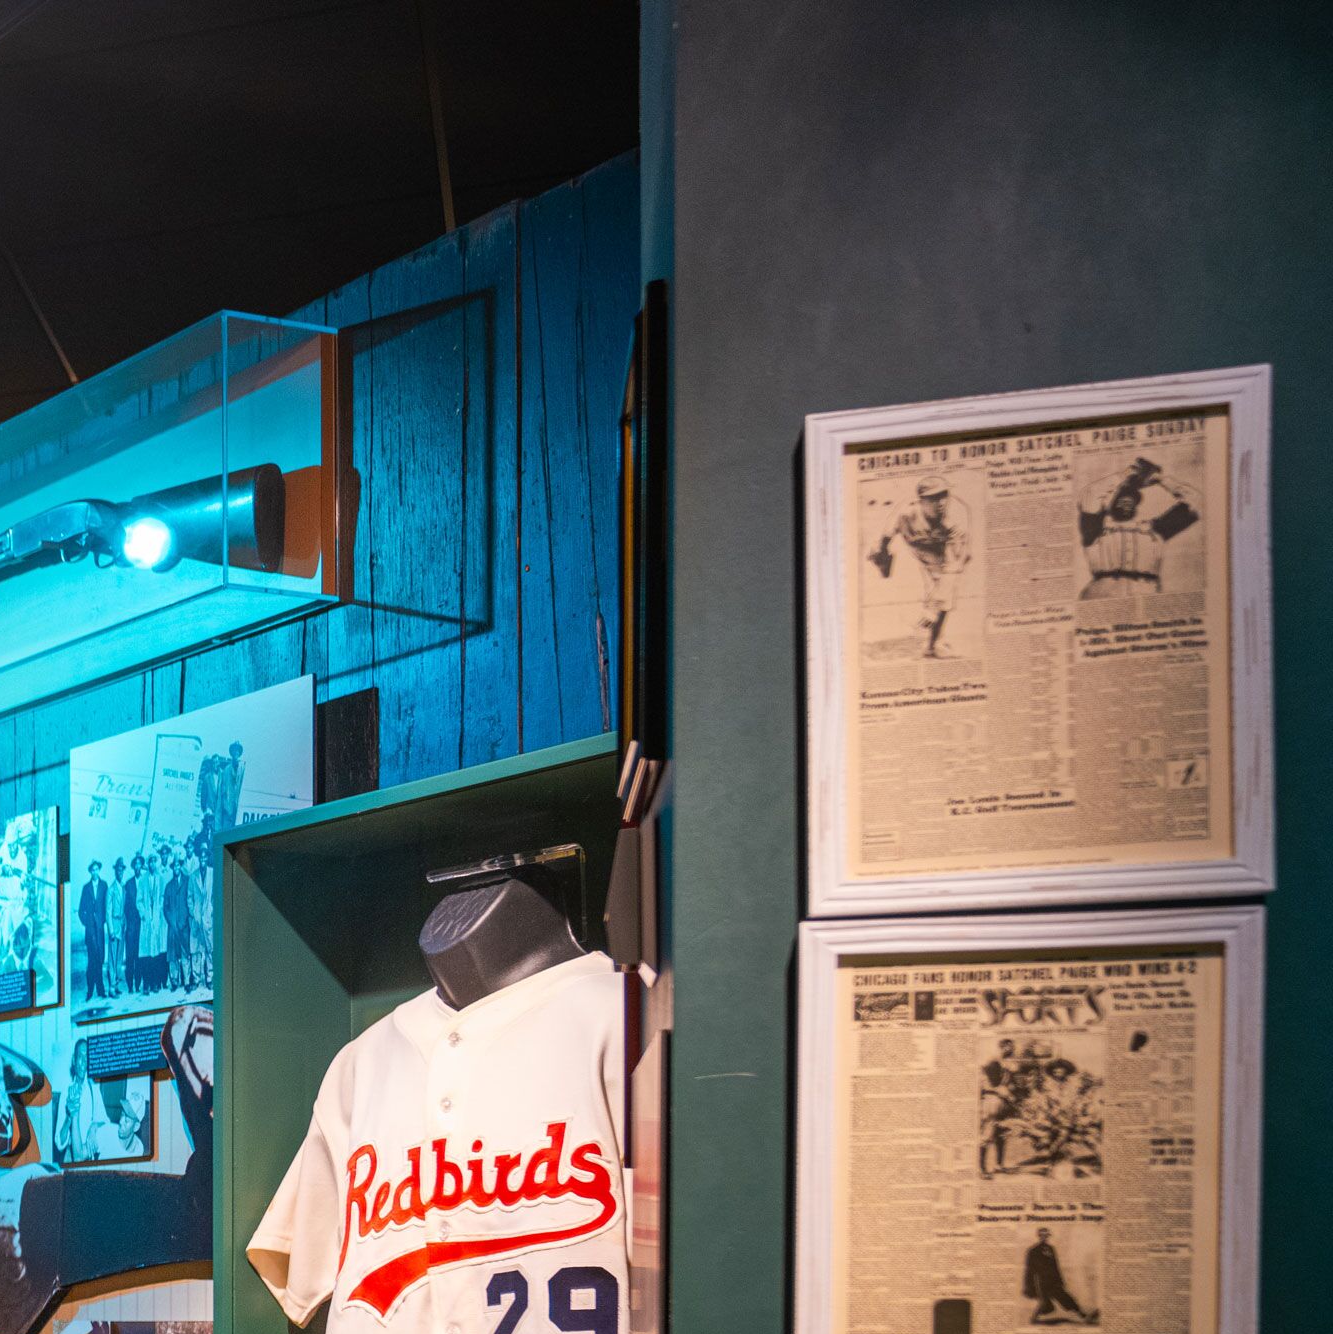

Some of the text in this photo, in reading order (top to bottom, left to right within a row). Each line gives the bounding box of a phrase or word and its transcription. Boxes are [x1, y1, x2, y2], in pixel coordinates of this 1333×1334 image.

[857, 417, 1207, 470] CHICAGO TO HONOR SATCHEL PAIGE SUNDAY
[1060, 967, 1096, 979] PAIGE
[1104, 964, 1131, 977] WHO
[1139, 962, 1170, 975] WINS
[1177, 961, 1197, 974] 4-2
[339, 1118, 621, 1270] Redbirds
